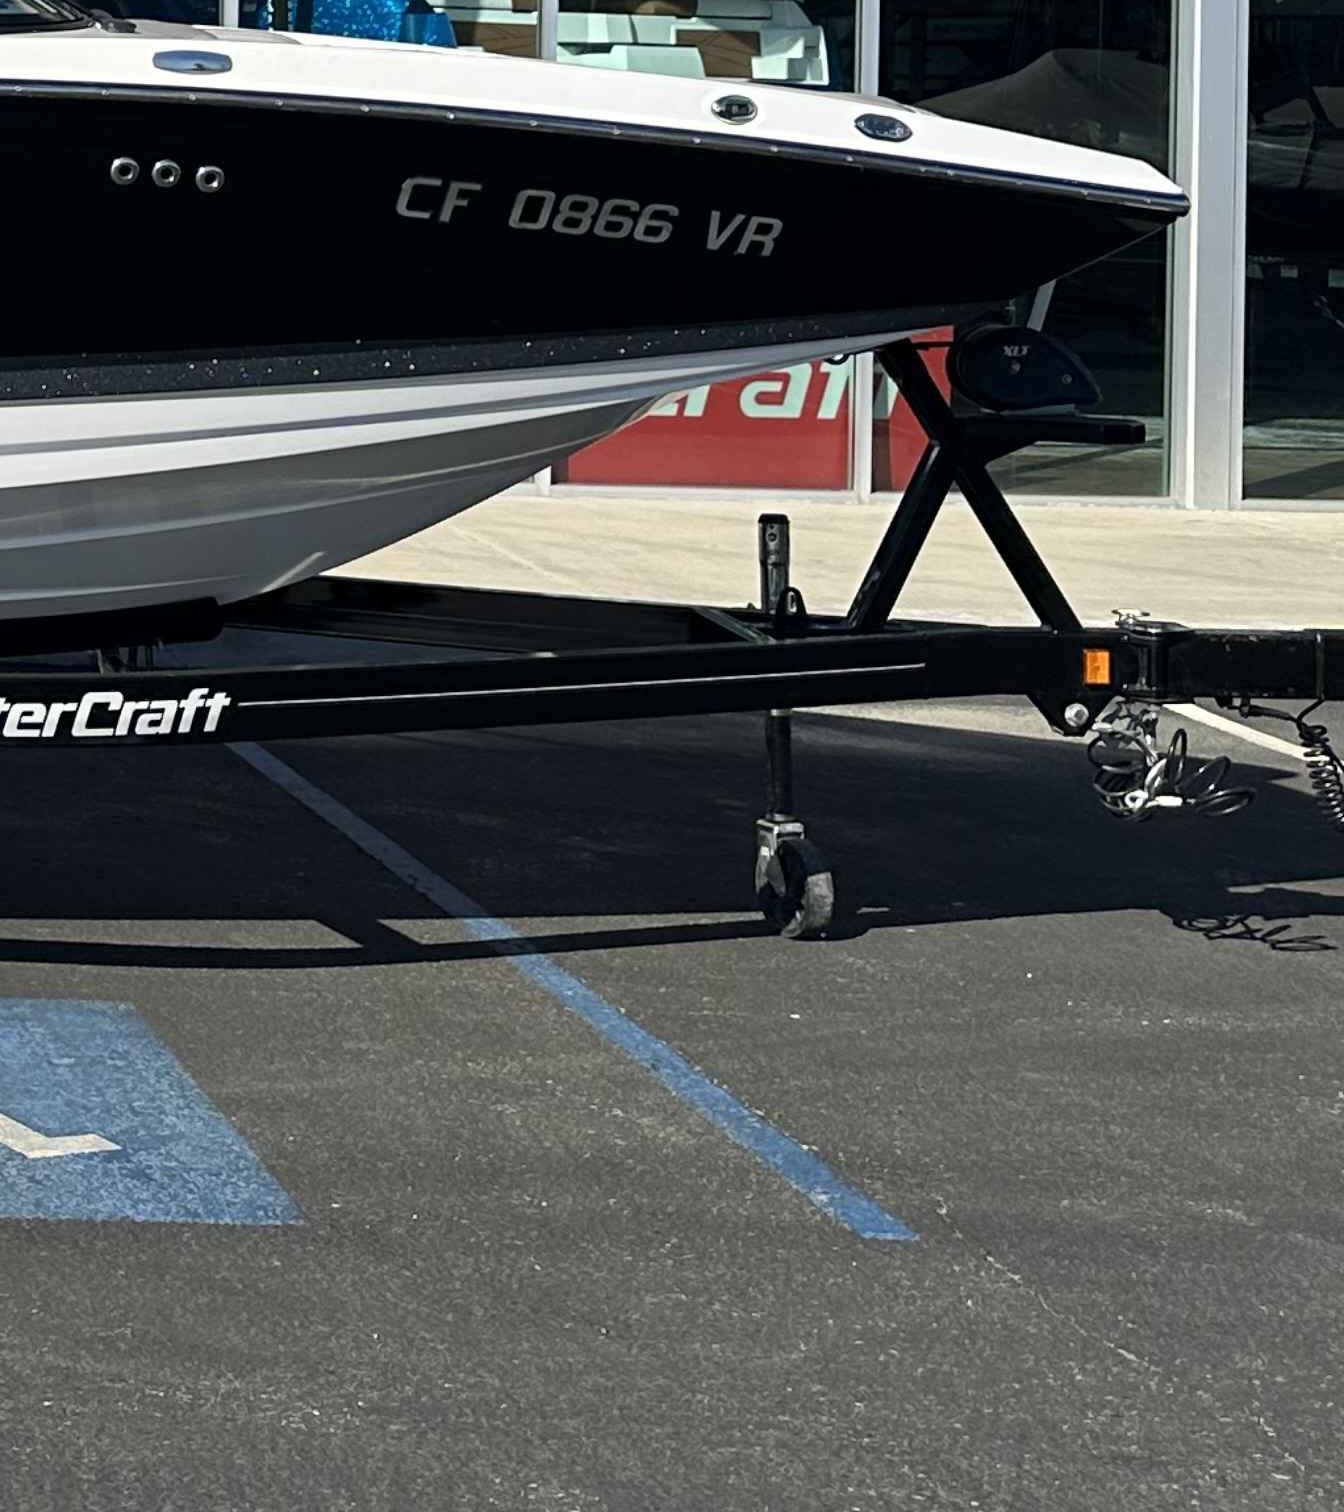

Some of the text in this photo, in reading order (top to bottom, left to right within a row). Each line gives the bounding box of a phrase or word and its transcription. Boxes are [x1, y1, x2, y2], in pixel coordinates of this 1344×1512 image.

[395, 177, 783, 257] CF 0866 VR
